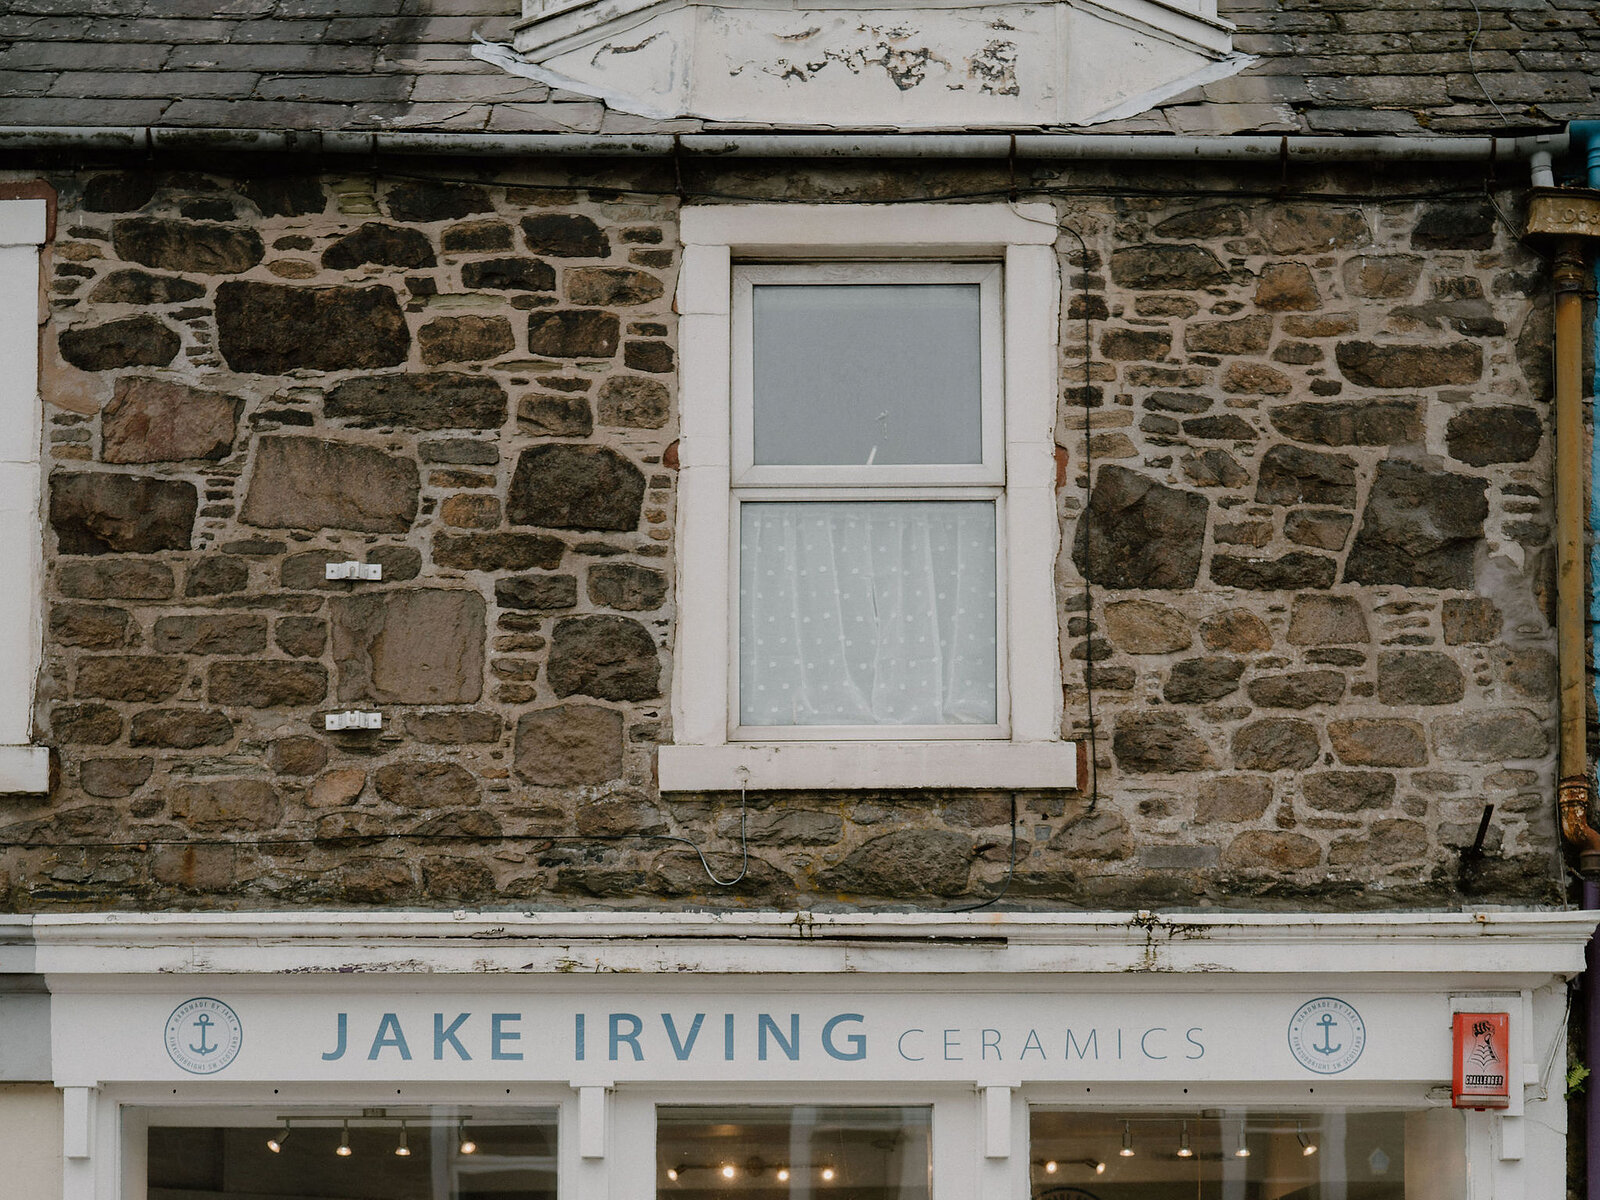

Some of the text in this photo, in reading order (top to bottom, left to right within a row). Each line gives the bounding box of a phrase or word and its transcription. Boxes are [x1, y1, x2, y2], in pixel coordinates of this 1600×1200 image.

[321, 1012, 1205, 1062] JAKE IRVING CERAMICS
[1465, 1074, 1504, 1086] CHALLENGER
